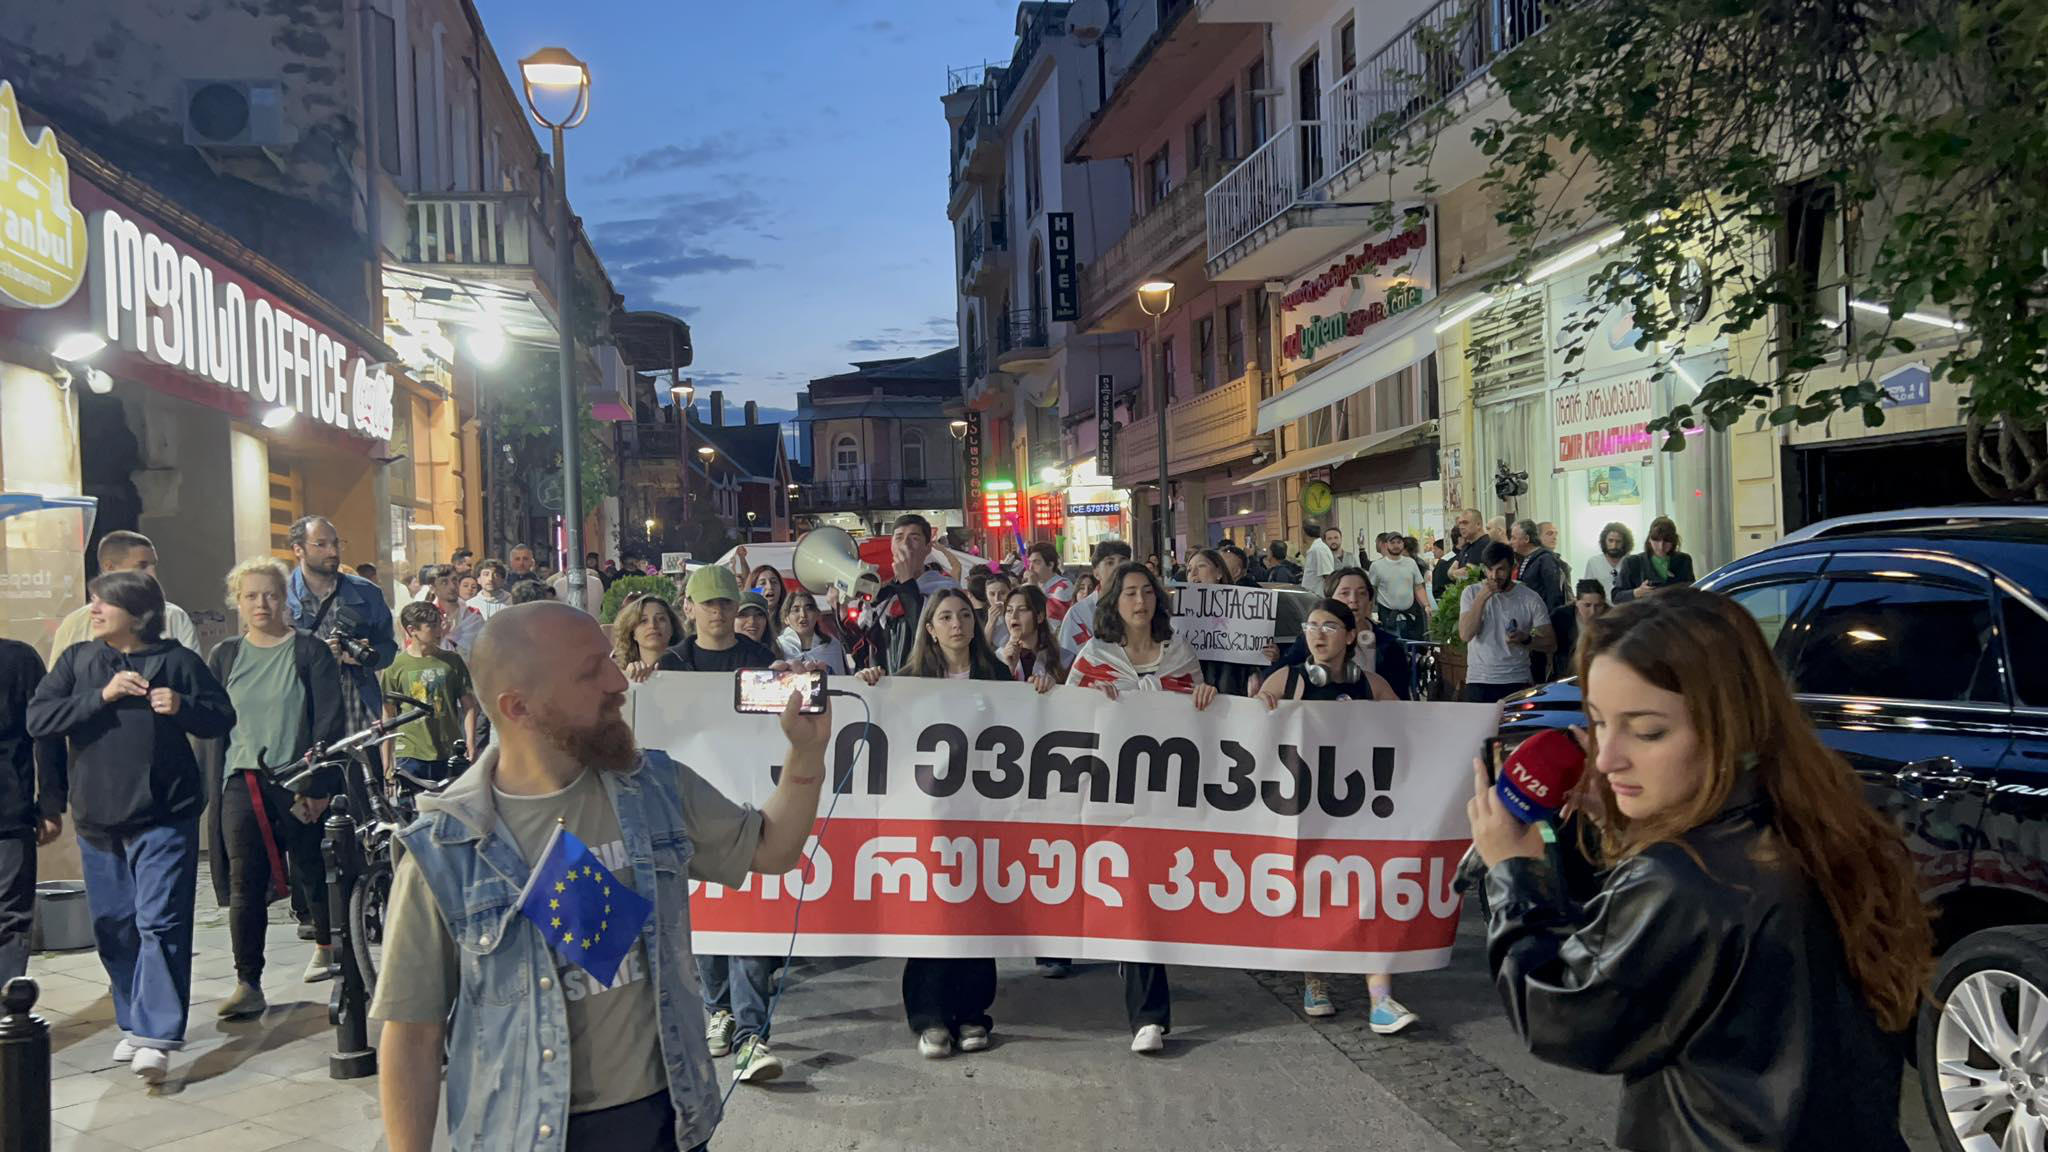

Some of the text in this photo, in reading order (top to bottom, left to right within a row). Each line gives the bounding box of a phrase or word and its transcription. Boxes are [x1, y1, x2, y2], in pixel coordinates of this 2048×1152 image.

[0, 205, 74, 270] anbul
[1054, 216, 1070, 307] HOTEL
[254, 298, 349, 430] OFFICE
[914, 722, 1396, 819] ევროპას!
[1512, 762, 1549, 798] TV25
[853, 835, 1130, 908] რუსულ
